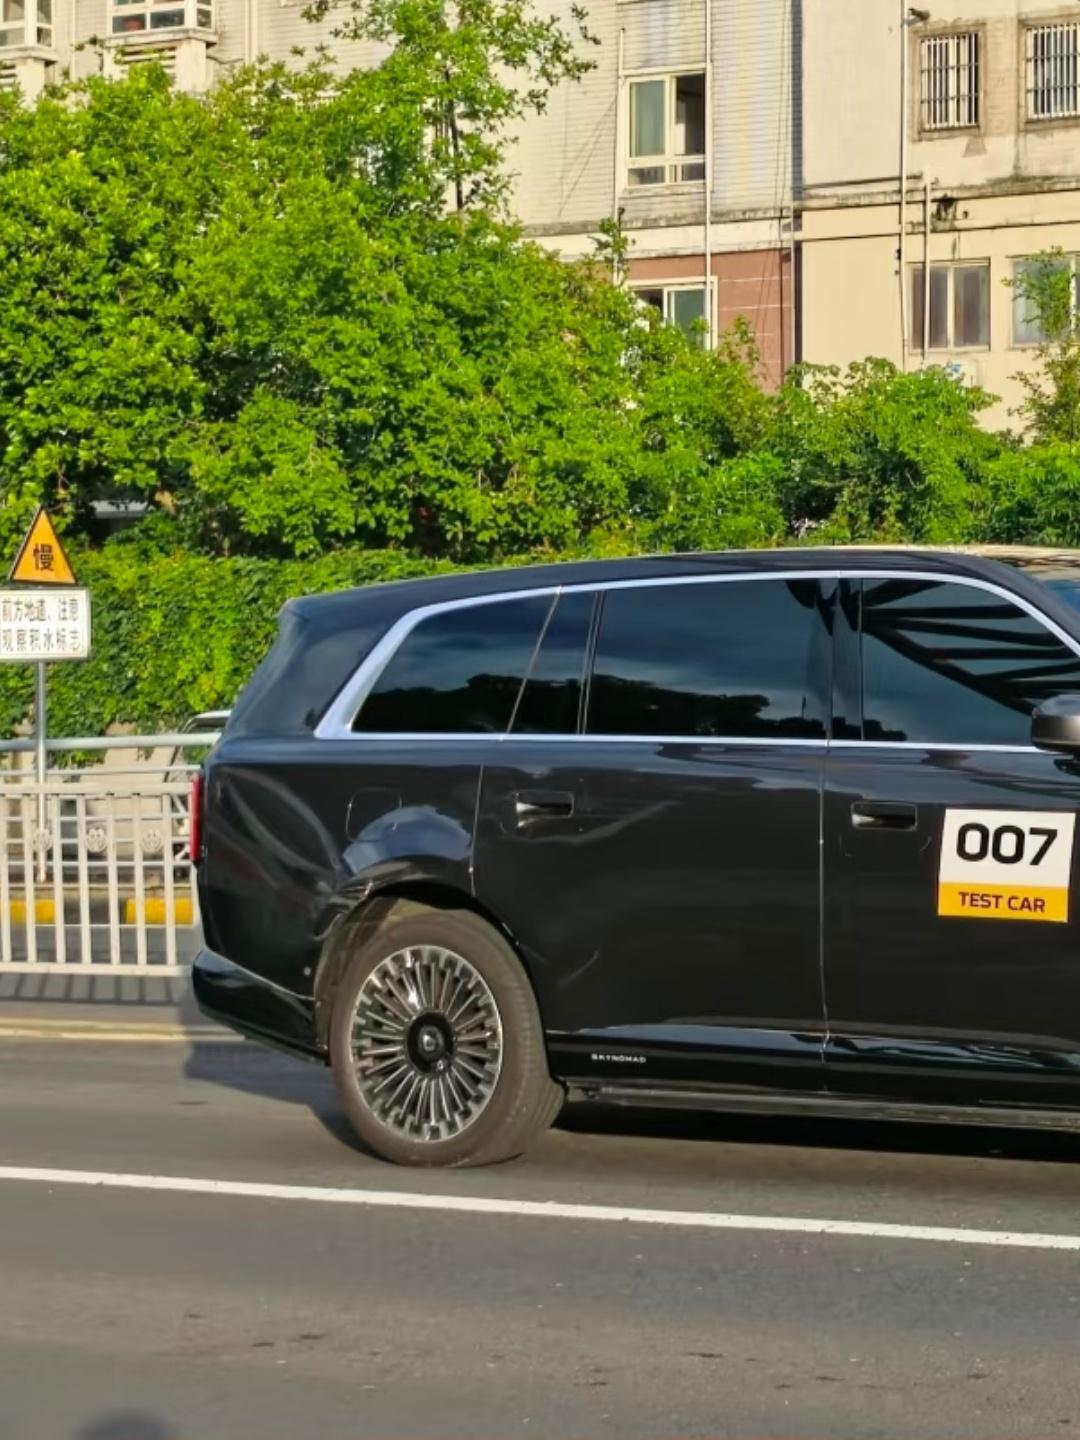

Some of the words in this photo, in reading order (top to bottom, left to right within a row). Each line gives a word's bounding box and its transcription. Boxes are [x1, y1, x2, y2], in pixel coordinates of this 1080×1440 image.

[33, 543, 54, 571] 慢
[956, 822, 1058, 866] 007
[958, 891, 1003, 909] TEST
[1007, 896, 1046, 912] CAR
